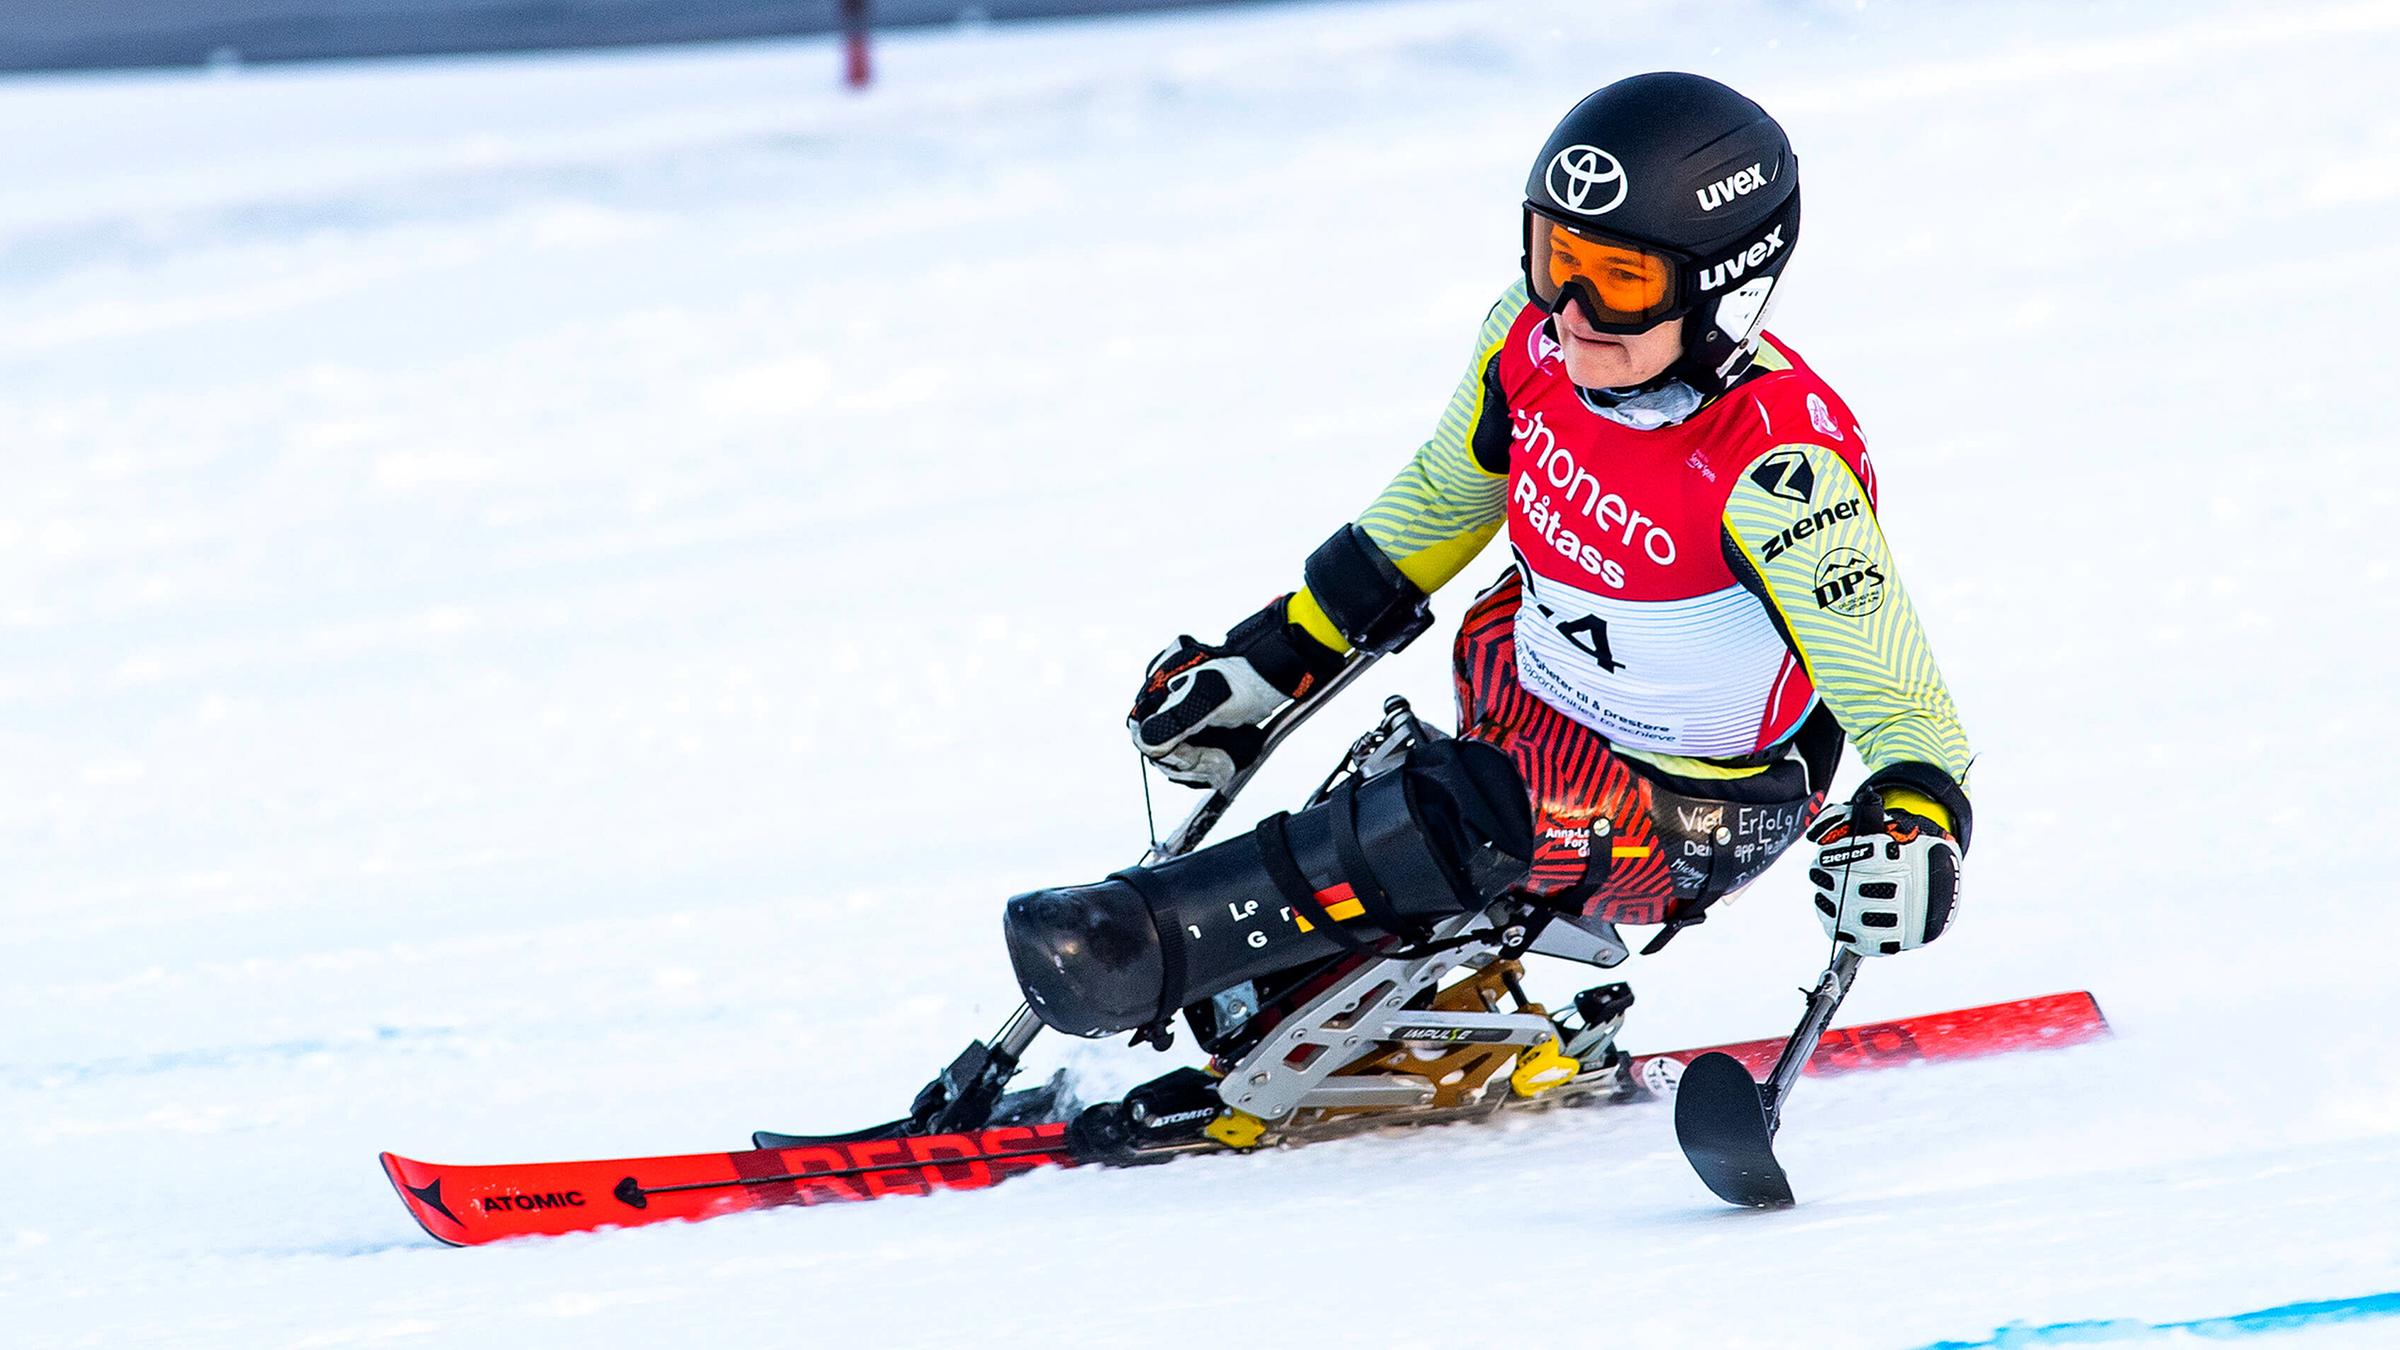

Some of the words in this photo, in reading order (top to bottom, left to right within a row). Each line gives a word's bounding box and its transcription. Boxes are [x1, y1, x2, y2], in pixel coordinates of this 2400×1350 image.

[1696, 162, 1768, 212] uvex
[1699, 224, 1785, 291] uvex
[1514, 470, 1625, 590] Råtass
[1760, 497, 1861, 564] ziener
[1811, 563, 1885, 610] DPS
[1576, 690, 1589, 704] til
[1603, 708, 1670, 732] prestere
[1599, 717, 1615, 728] to
[1618, 726, 1677, 743] achieve
[1677, 805, 1724, 833] Viel
[1738, 804, 1804, 845] Erfolg!
[1247, 930, 1269, 949] G
[1402, 1028, 1473, 1041] IMPULSE
[1150, 1107, 1215, 1129] ATOMIC
[484, 1190, 586, 1212] ATOMIC
